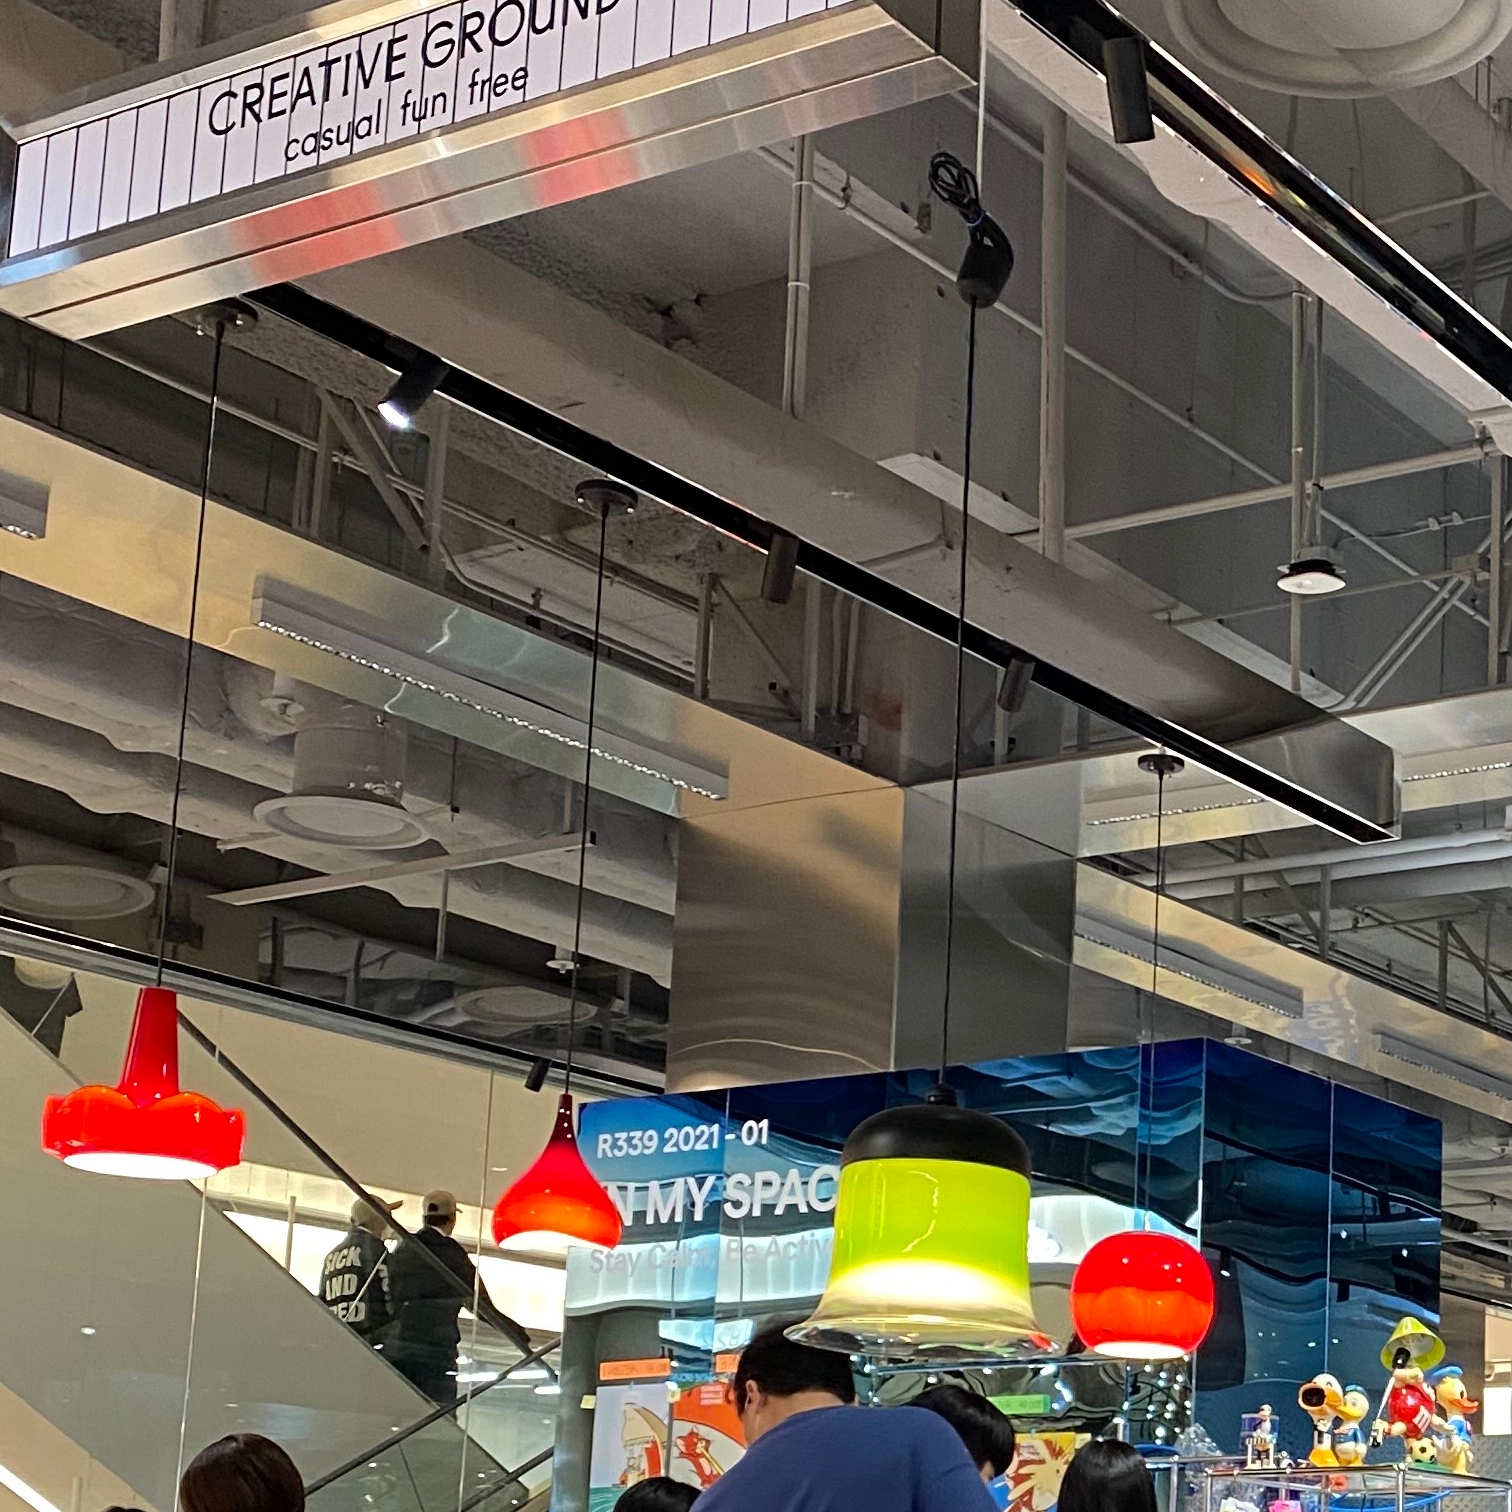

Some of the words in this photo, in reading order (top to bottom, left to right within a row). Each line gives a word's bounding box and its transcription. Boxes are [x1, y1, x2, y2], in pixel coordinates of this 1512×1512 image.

[208, 33, 409, 136] CREATIVE
[284, 99, 381, 162] casual
[400, 88, 448, 127] fun
[469, 66, 529, 106] free
[597, 1129, 658, 1158] R339
[663, 1123, 720, 1154] 2021
[741, 1118, 769, 1147] 01
[604, 1181, 636, 1227] N
[646, 1174, 717, 1226] MY
[723, 1164, 841, 1220] SPAC
[324, 1245, 362, 1276] SICK
[589, 1248, 642, 1277] Stay
[726, 1237, 756, 1263] Be
[768, 1231, 835, 1259] Activ
